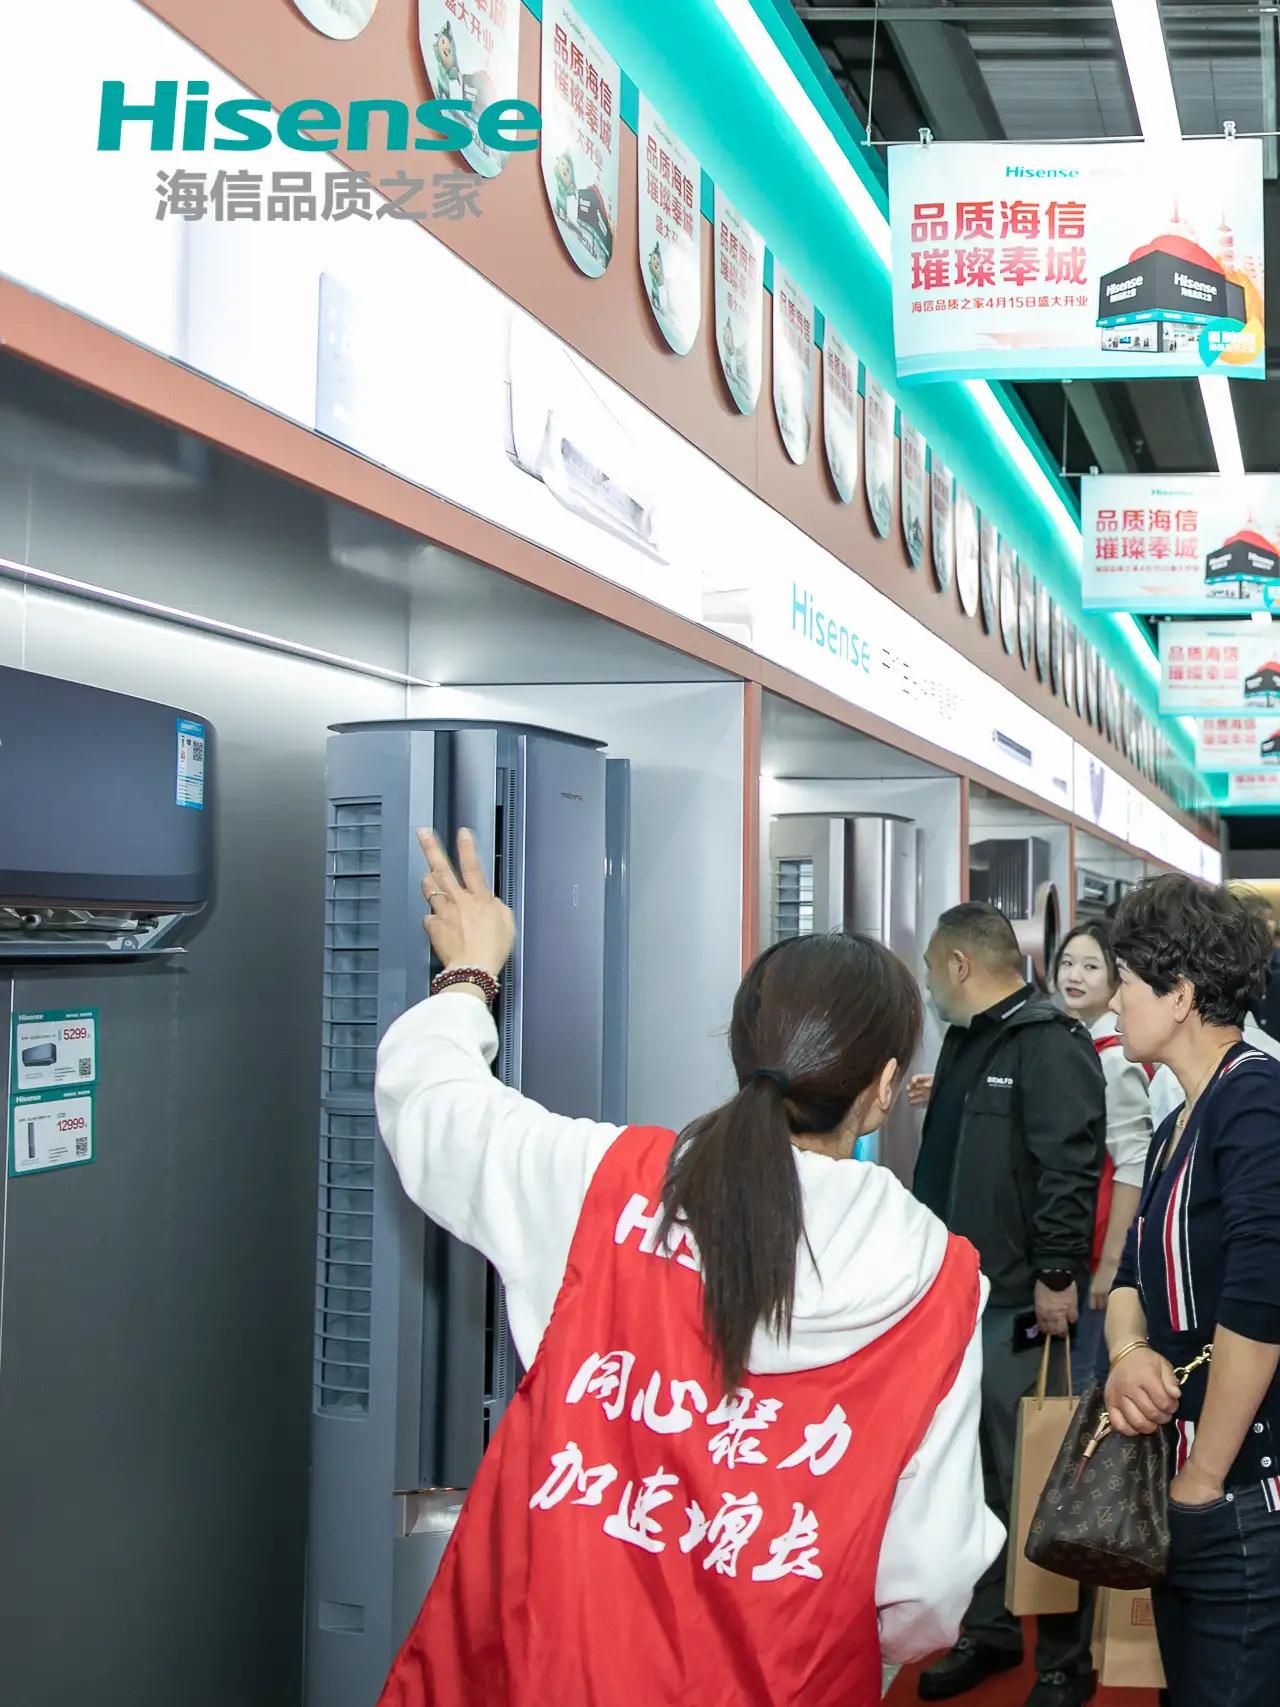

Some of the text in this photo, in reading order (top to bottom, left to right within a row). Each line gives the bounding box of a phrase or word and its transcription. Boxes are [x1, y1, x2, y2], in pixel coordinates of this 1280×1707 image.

[554, 23, 612, 117] 品质海信
[647, 135, 693, 208] 品质海信
[1005, 166, 1080, 178] Hisense
[911, 200, 1087, 243] 品质海信
[911, 246, 1087, 290] 璀璨奉城
[1174, 272, 1218, 296] Hisense
[912, 296, 1088, 313] 海信品质之家4月15日盛大开业
[1096, 509, 1198, 532] 品质海信
[793, 581, 871, 674] Hisense
[63, 1028, 87, 1040] 5299
[57, 1117, 84, 1131] 12999
[565, 1350, 853, 1476] 同心聚力
